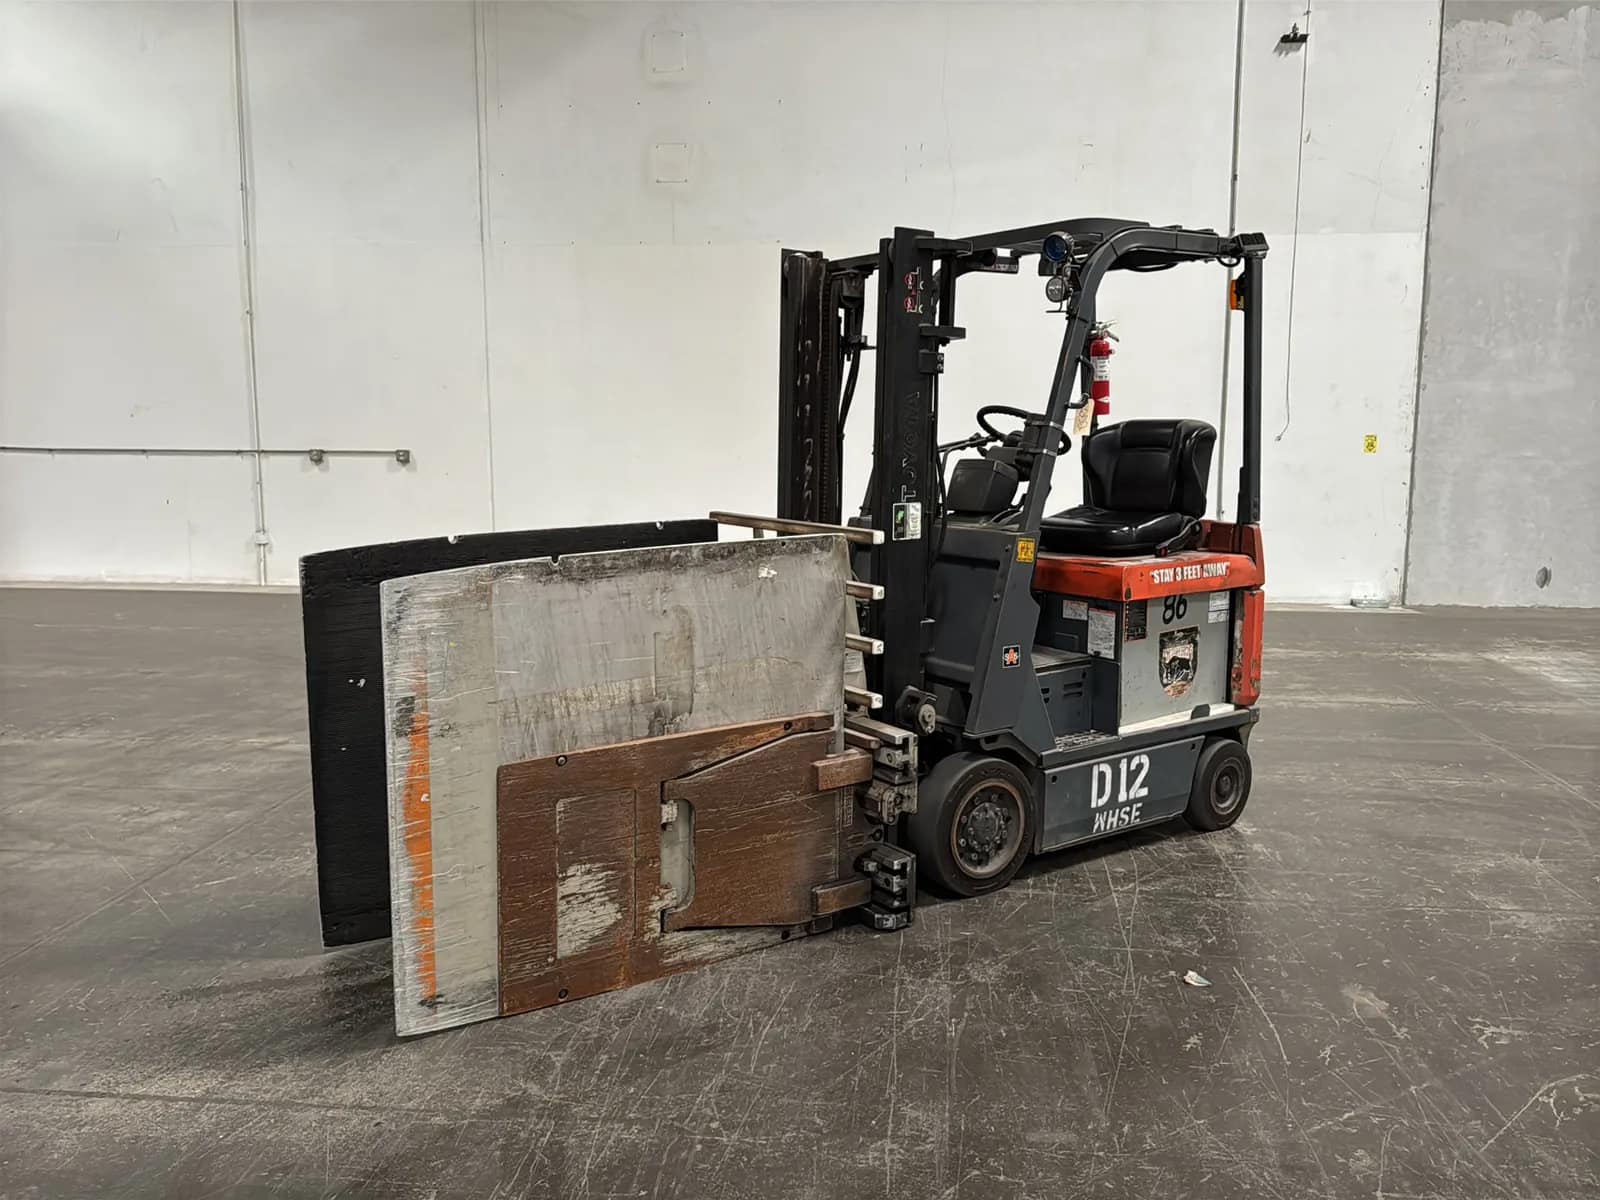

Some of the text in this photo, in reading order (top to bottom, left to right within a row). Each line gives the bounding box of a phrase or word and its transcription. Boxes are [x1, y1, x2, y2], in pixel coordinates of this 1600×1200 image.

[901, 391, 920, 503] TOYOTA
[1175, 567, 1182, 580] 3
[1183, 565, 1201, 580] FEET
[1162, 594, 1188, 624] 86
[1093, 802, 1143, 833] WHSE
